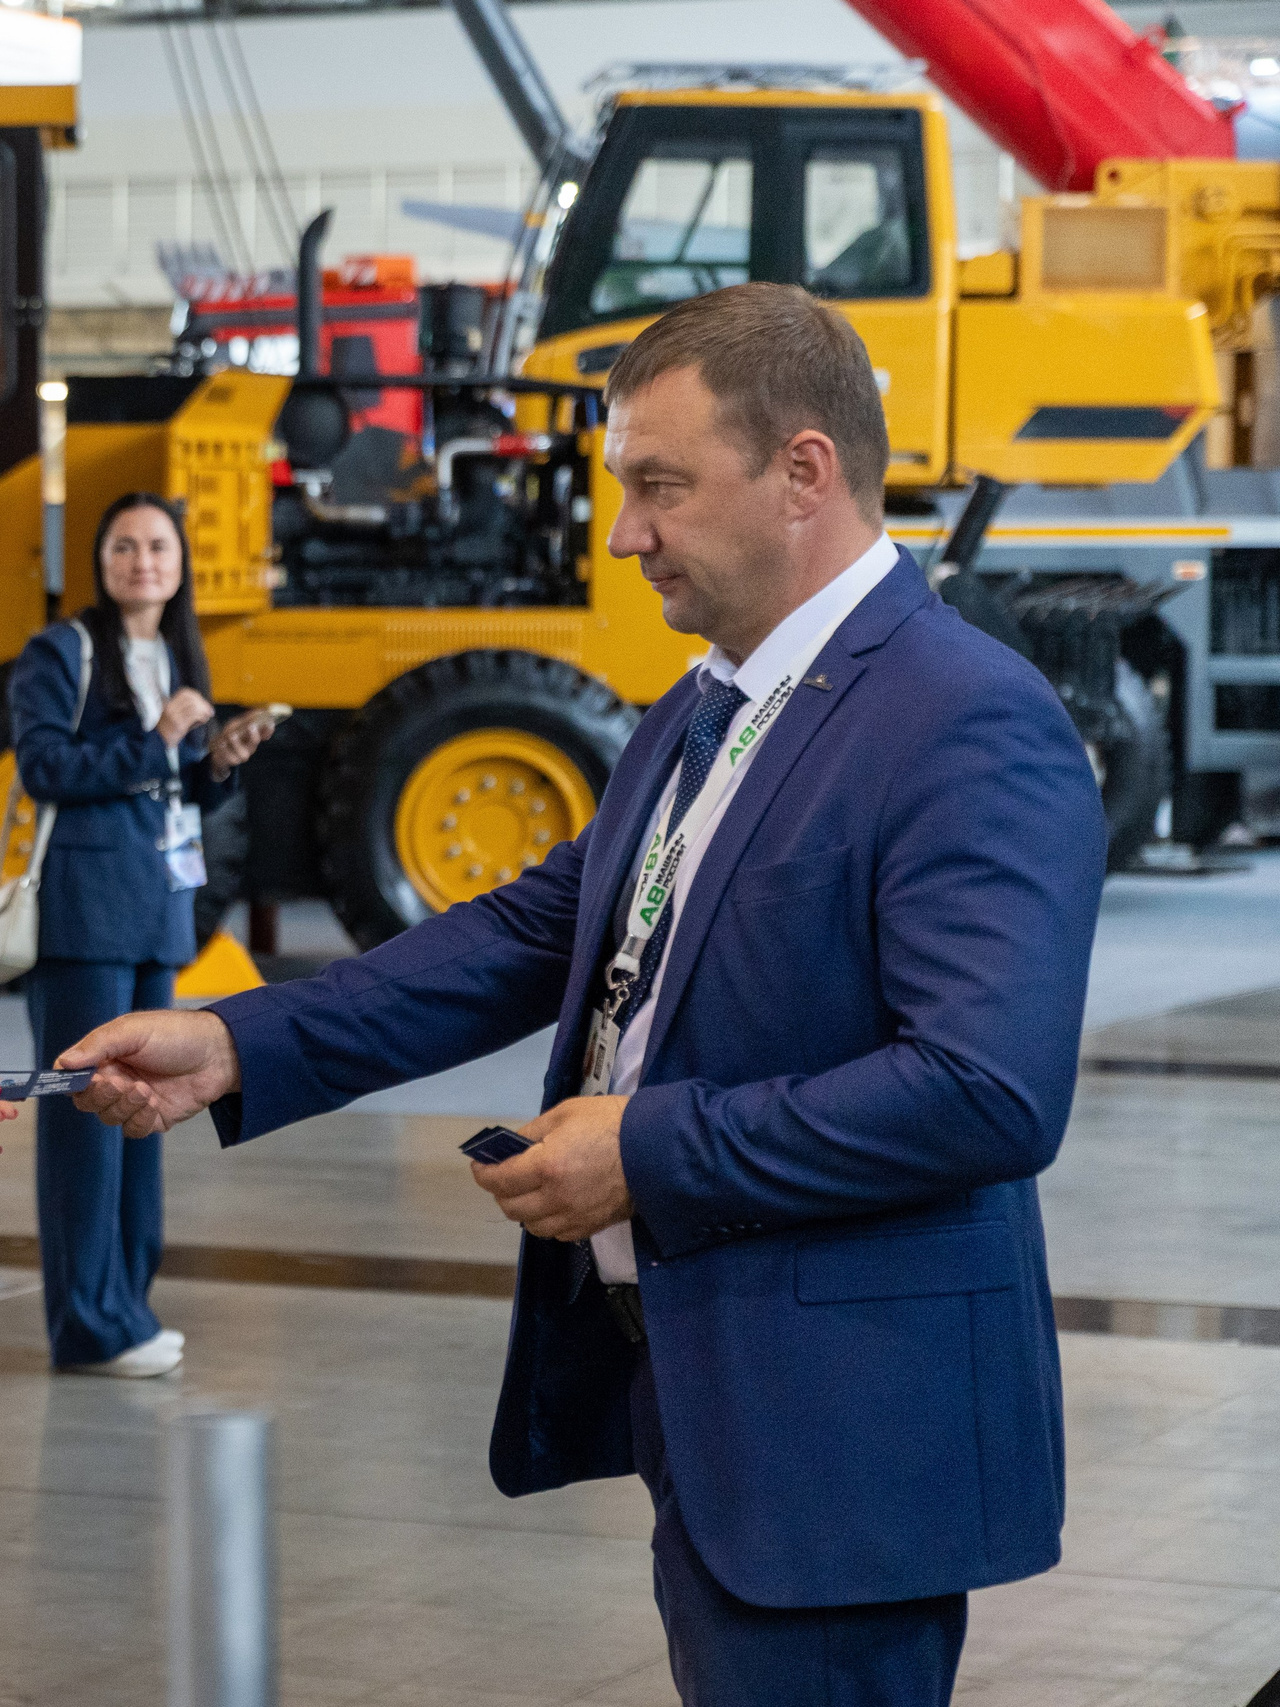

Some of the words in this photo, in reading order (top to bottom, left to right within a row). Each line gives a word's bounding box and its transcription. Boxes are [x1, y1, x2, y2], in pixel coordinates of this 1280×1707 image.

[751, 674, 791, 725] МАШИНЫ
[756, 686, 794, 730] РОССИИ
[655, 833, 684, 884] МАШИНЫ
[663, 844, 686, 888] РОССИИ
